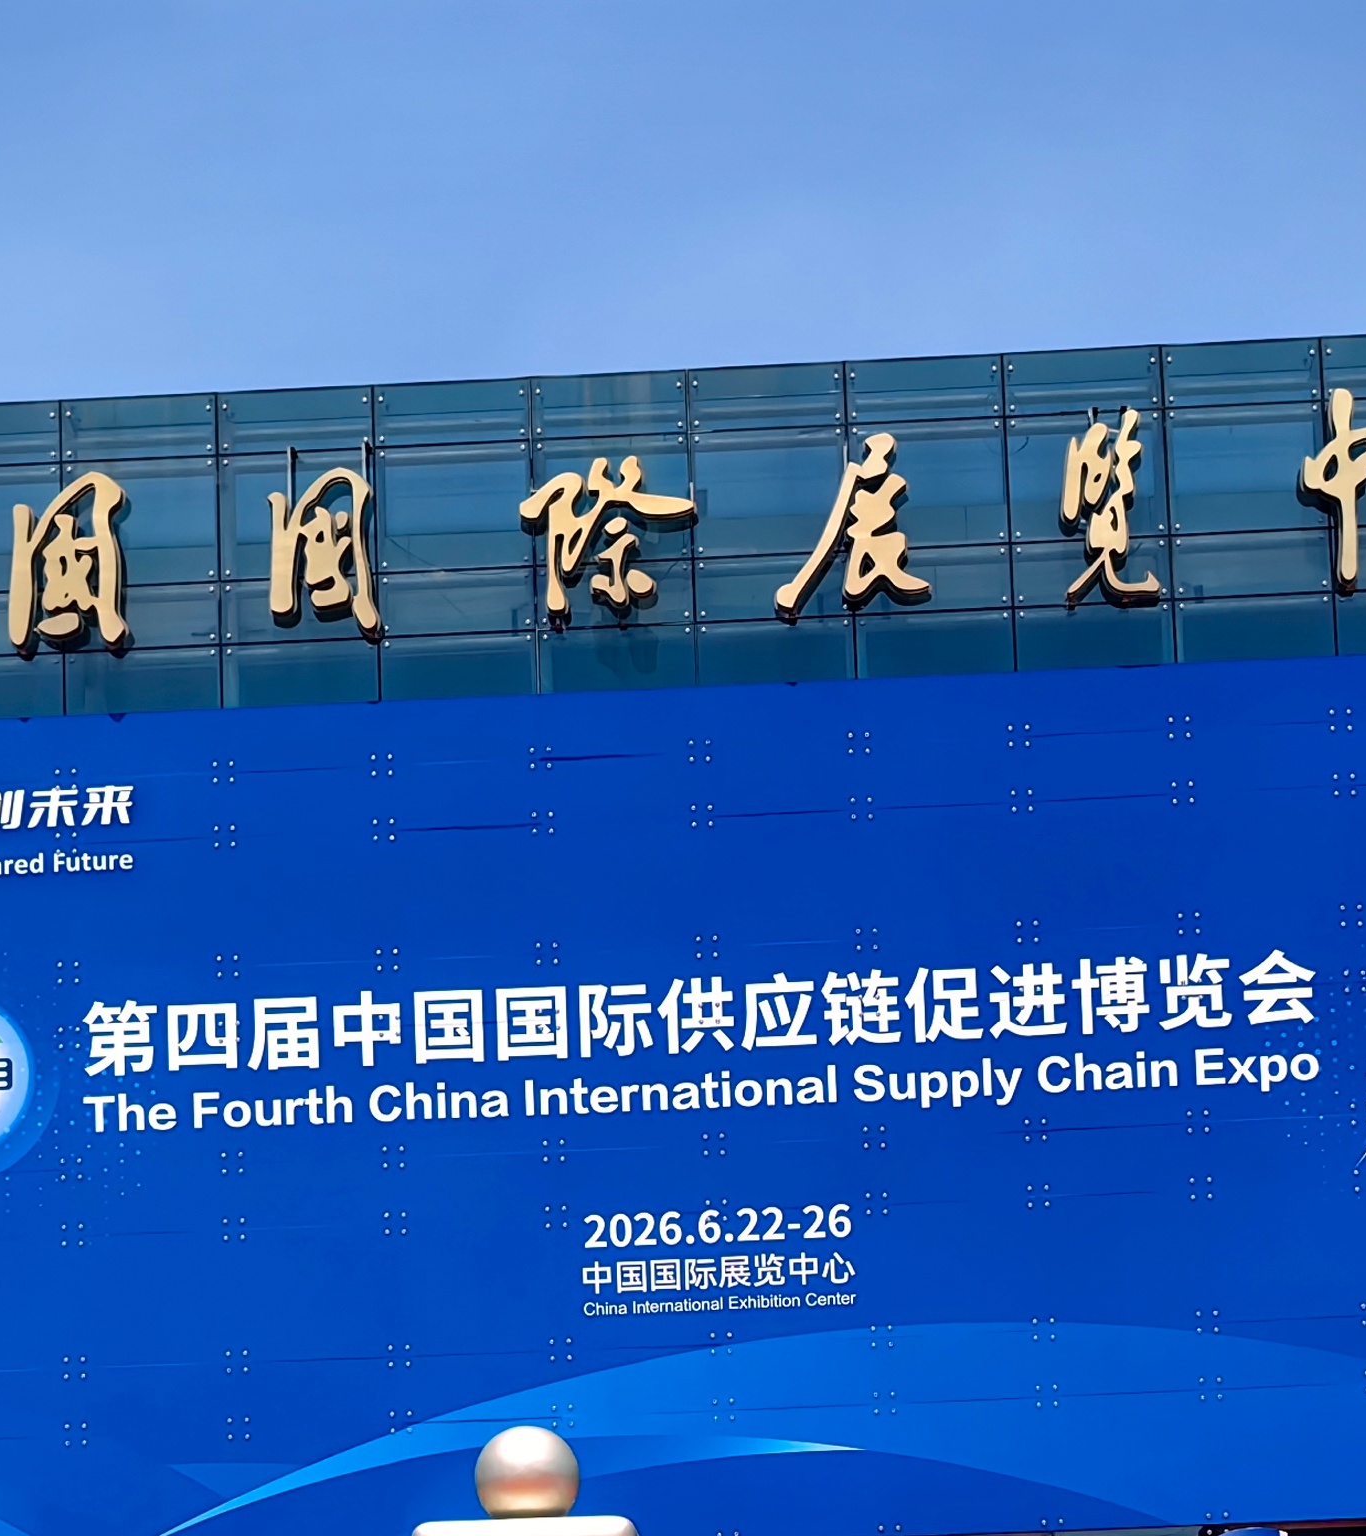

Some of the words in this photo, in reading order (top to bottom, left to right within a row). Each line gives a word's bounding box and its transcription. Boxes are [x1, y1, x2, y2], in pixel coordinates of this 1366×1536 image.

[53, 848, 134, 873] Future
[83, 949, 1317, 1077] 第四届中国国际供应链促进博览会
[82, 1093, 177, 1133] The
[192, 1085, 353, 1129] Fourth
[369, 1081, 509, 1122] China
[524, 1064, 838, 1117] International
[853, 1057, 1023, 1109] Supply
[1037, 1050, 1178, 1094] Chain
[1194, 1047, 1320, 1092] Expo
[582, 1203, 853, 1249] 2026.6.22-26
[581, 1251, 856, 1295] 中国国际展览中心
[583, 1301, 628, 1316] China
[632, 1296, 724, 1314] International
[728, 1294, 801, 1310] Exhibition
[805, 1292, 857, 1307] Center
